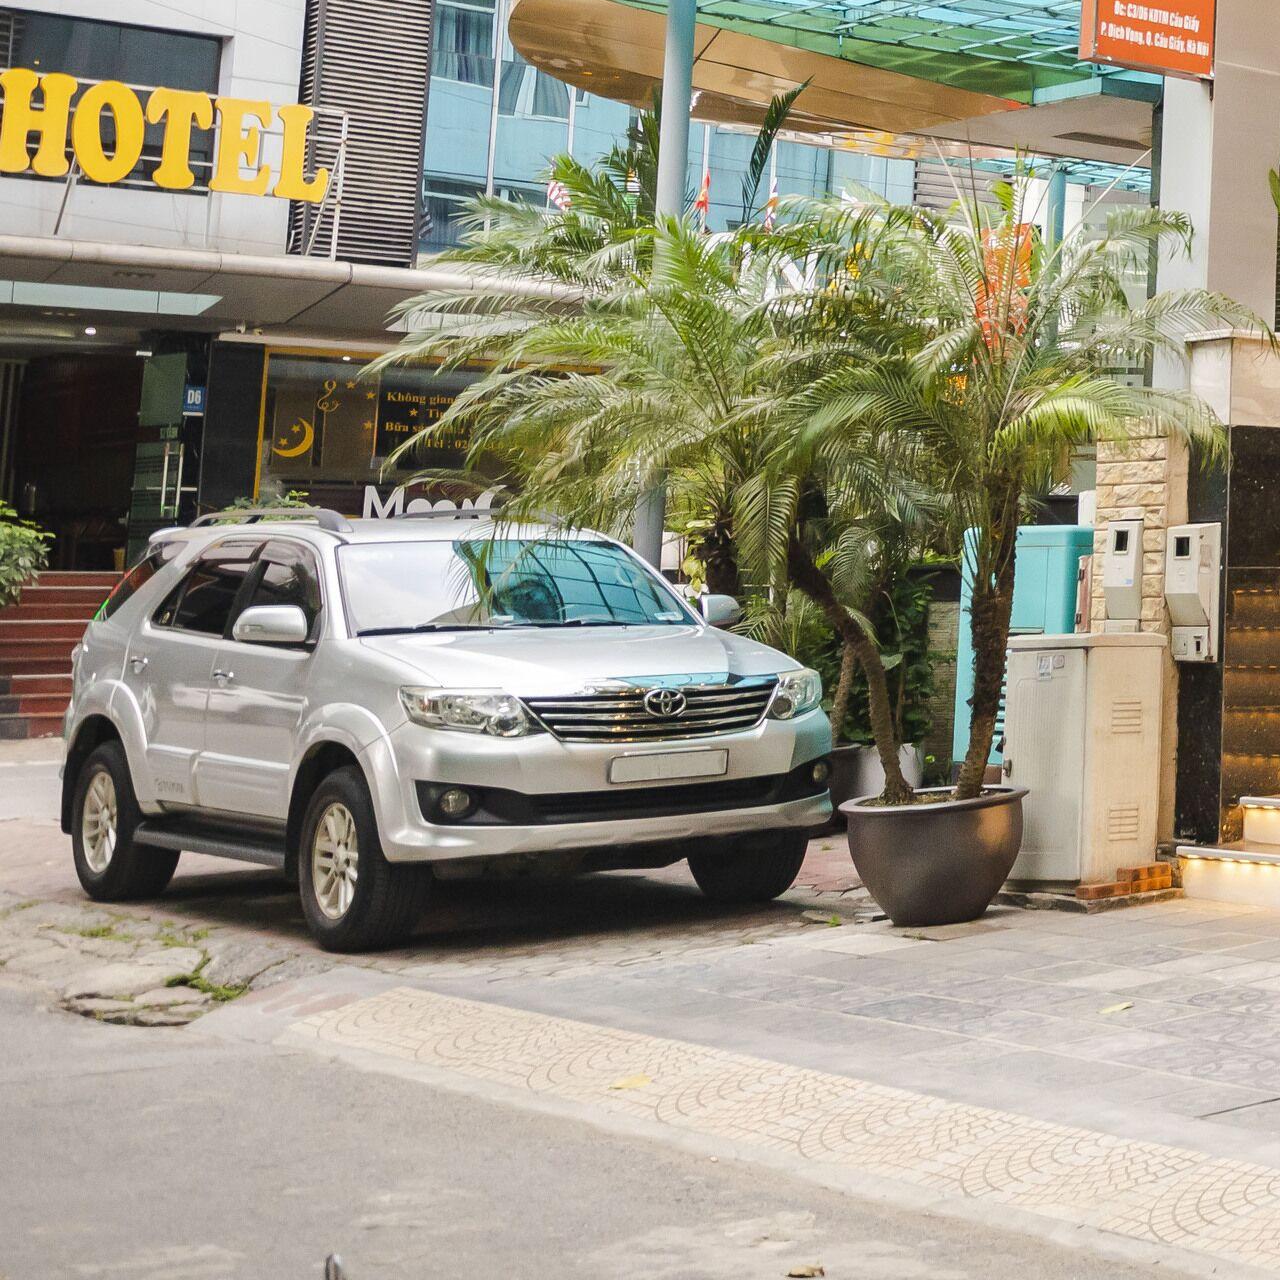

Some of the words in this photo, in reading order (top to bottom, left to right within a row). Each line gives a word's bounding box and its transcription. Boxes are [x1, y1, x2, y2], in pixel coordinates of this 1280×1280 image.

[0, 68, 329, 203] HOTEL
[187, 389, 202, 405] D6
[386, 392, 426, 405] Không
